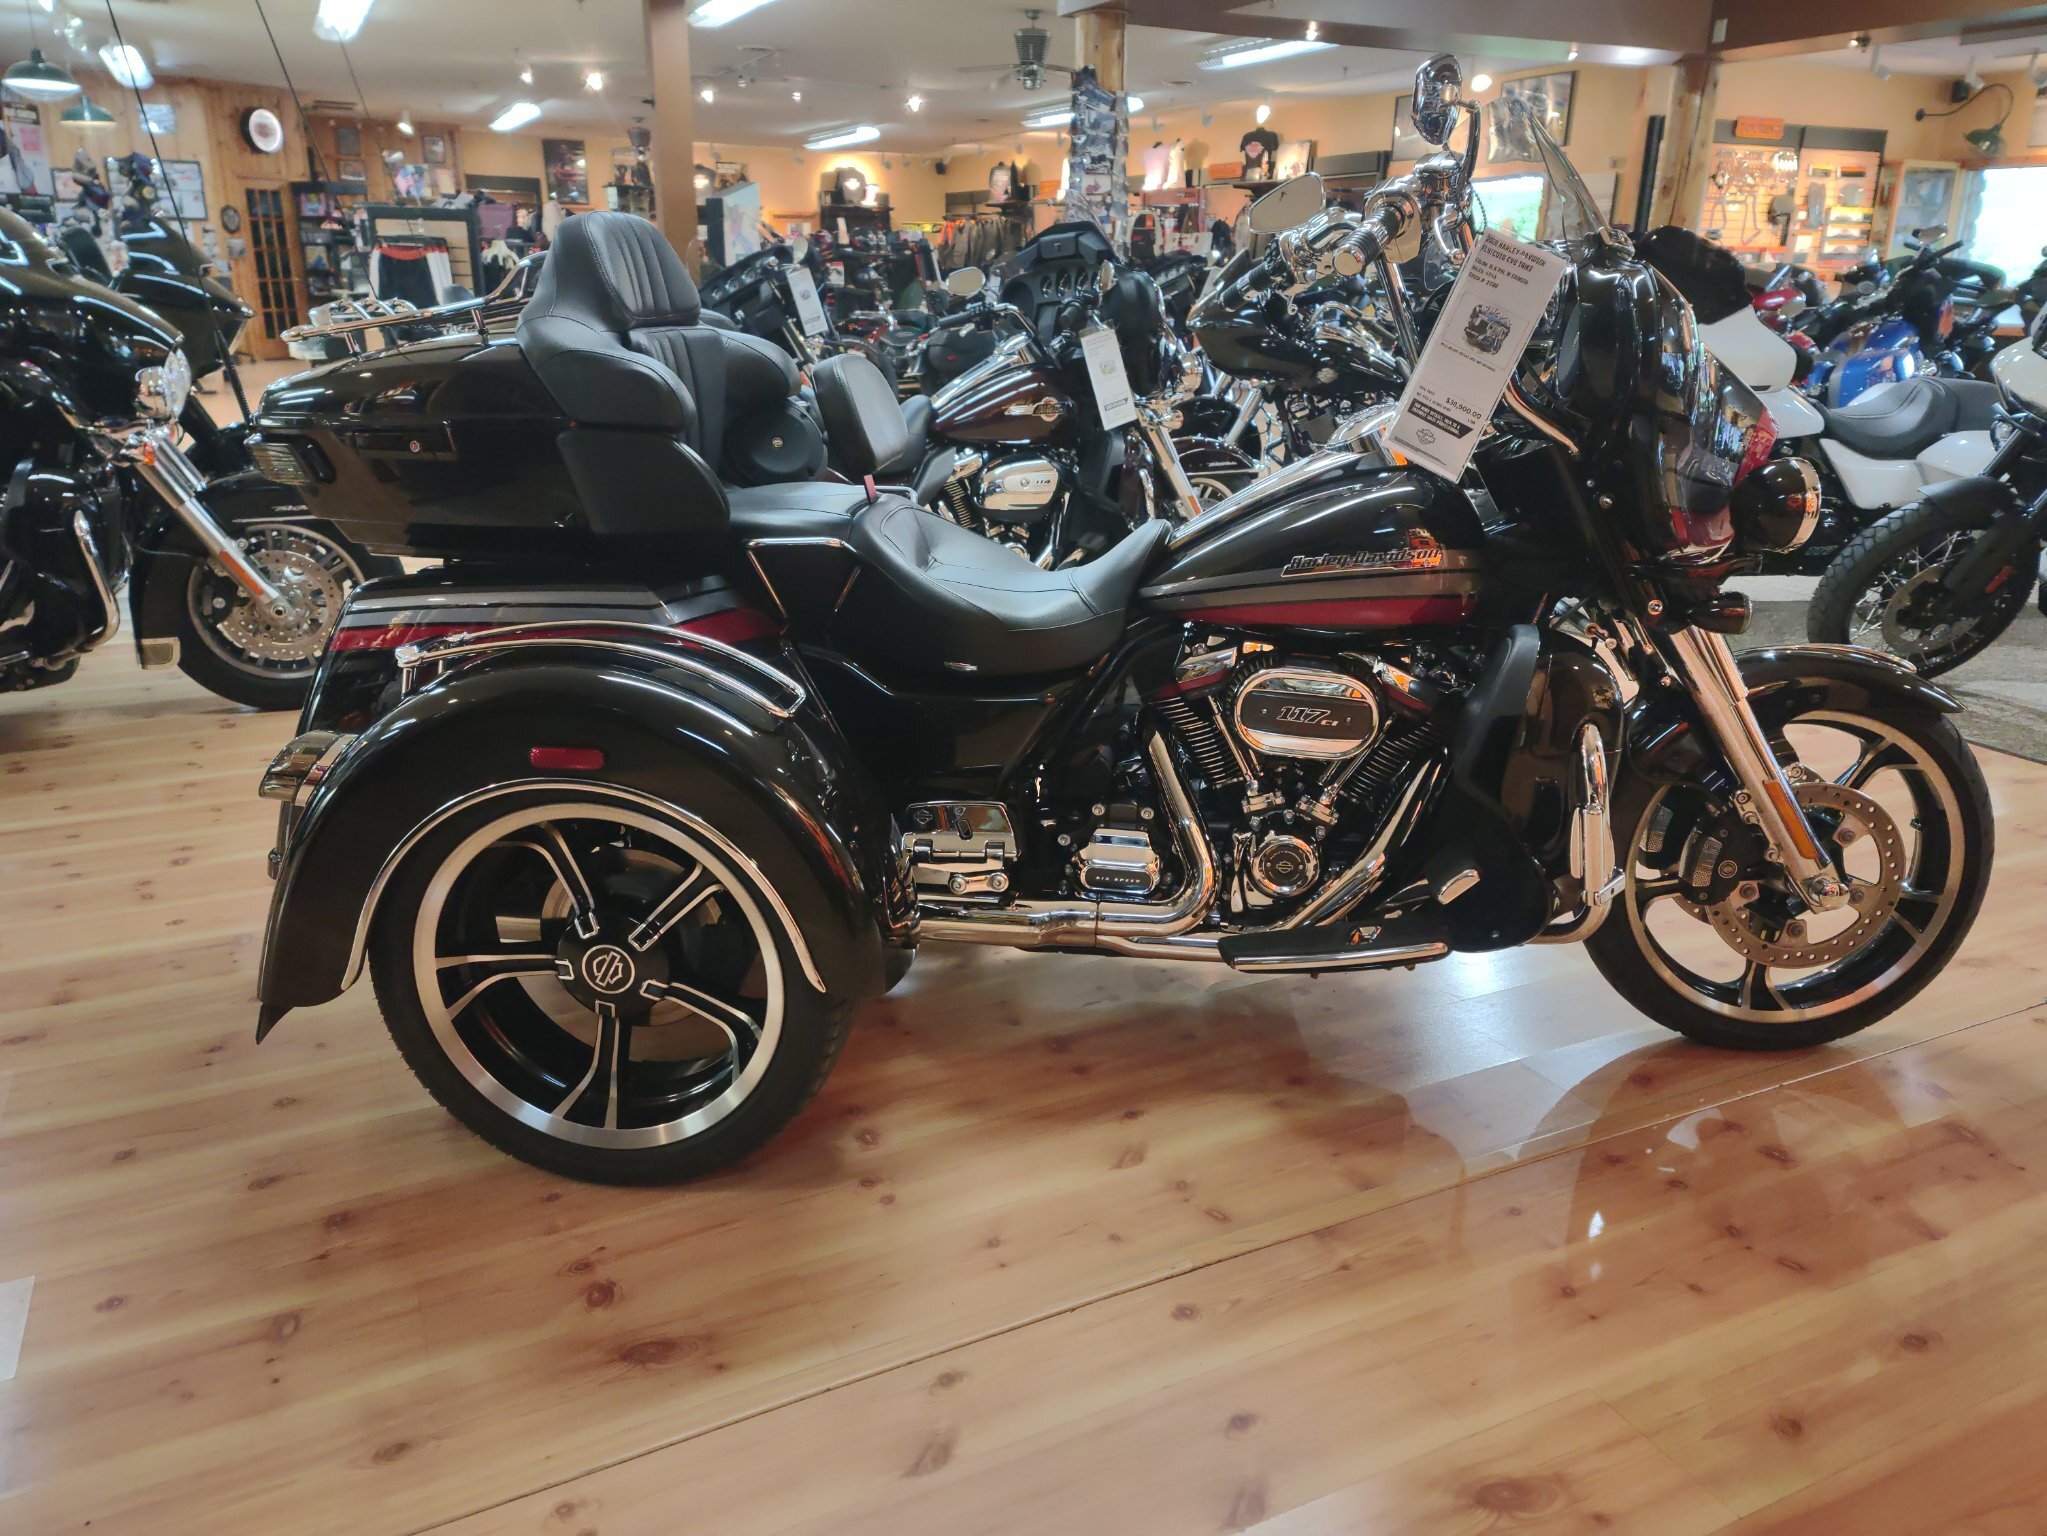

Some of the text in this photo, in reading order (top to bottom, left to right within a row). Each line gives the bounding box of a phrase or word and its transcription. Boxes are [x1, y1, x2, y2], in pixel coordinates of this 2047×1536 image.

[1485, 234, 1547, 266] 2020 HARLEY-DAVIDSON
[1505, 256, 1518, 265] CVO
[1517, 261, 1533, 272] TRIKE
[1445, 397, 1482, 420] $38,900.00
[1286, 547, 1443, 573] Harley-Davidson
